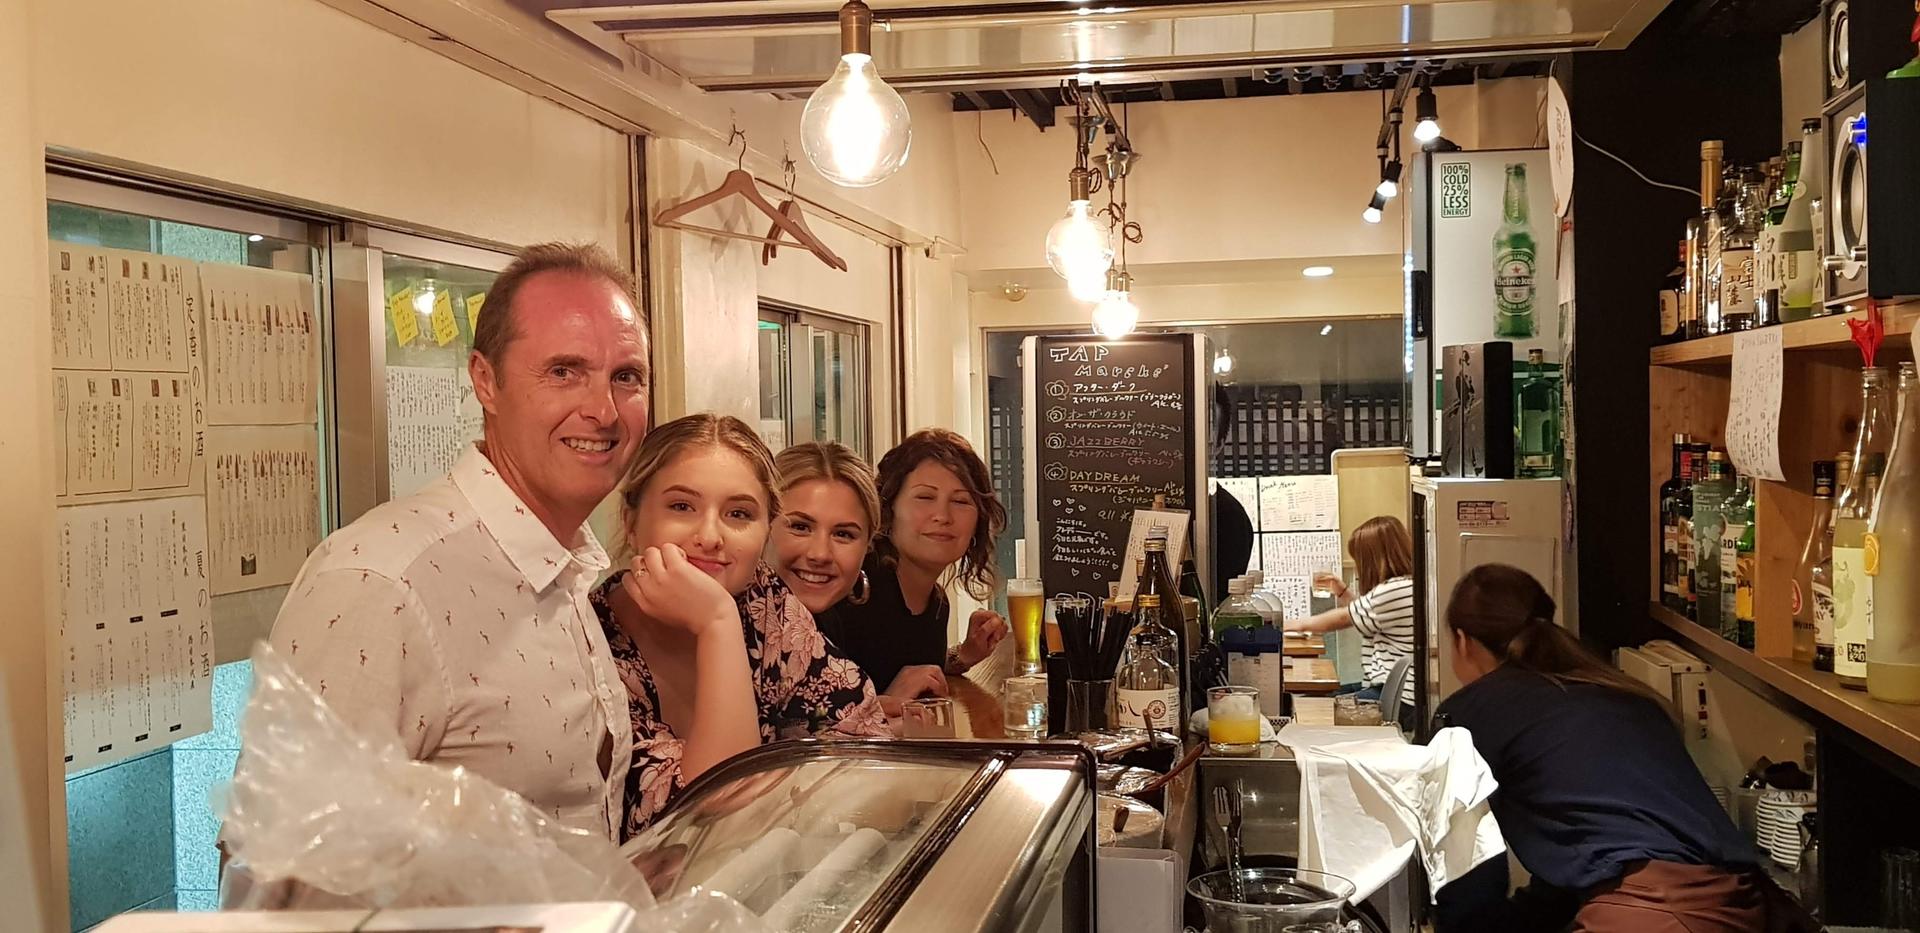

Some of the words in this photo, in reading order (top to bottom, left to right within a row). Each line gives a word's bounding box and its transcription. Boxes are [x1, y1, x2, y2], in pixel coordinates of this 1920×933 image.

[1443, 165, 1469, 175] 100%
[1443, 175, 1469, 185] COLD
[1443, 185, 1469, 196] 25%
[1443, 196, 1469, 208] LESS
[1443, 208, 1469, 216] ENERGY
[1050, 345, 1110, 362] TAP
